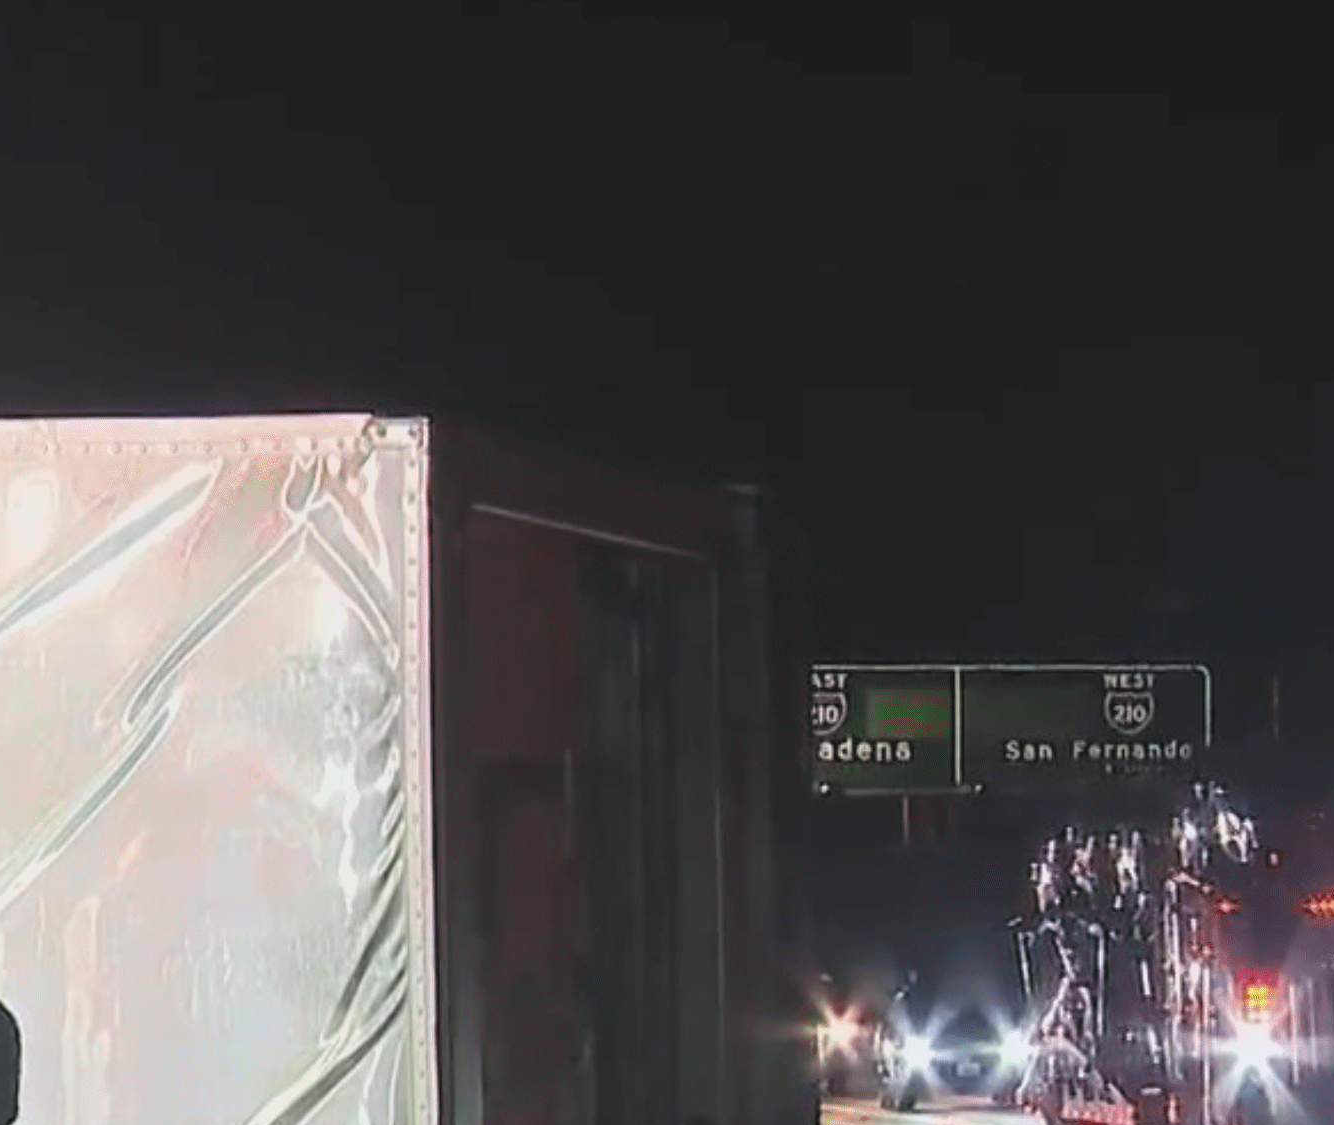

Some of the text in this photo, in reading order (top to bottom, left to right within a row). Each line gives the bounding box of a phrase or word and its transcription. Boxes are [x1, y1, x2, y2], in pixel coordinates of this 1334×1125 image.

[811, 673, 848, 689] AST
[1103, 673, 1155, 689] WEST
[1113, 703, 1147, 724] 210
[817, 736, 912, 762] adena
[1005, 740, 1193, 761] San Fernando
